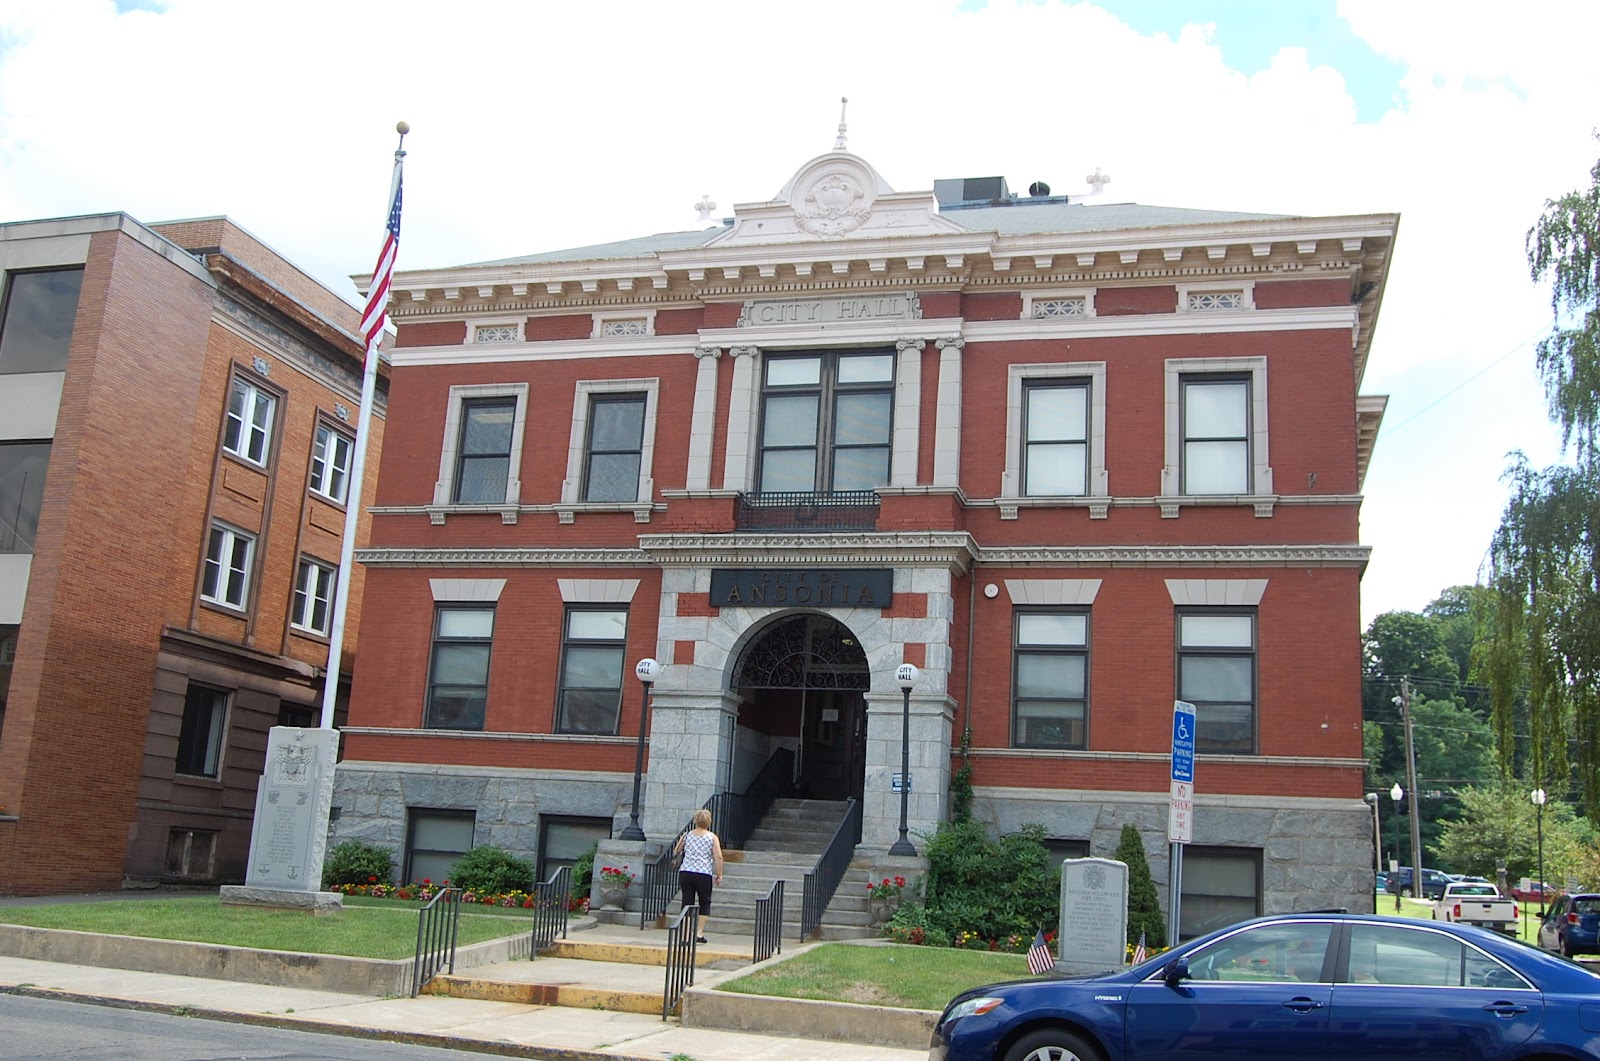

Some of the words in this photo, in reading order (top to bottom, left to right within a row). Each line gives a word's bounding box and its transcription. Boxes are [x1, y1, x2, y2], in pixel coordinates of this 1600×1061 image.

[760, 303, 820, 322] CITY
[837, 299, 904, 319] HALL
[761, 572, 805, 583] CITY
[821, 572, 840, 583] OF
[726, 584, 874, 604] ANSONIA
[1174, 747, 1192, 758] PARKING
[1177, 786, 1186, 798] NO
[1172, 798, 1191, 811] PARKING
[1175, 820, 1185, 829] TIME
